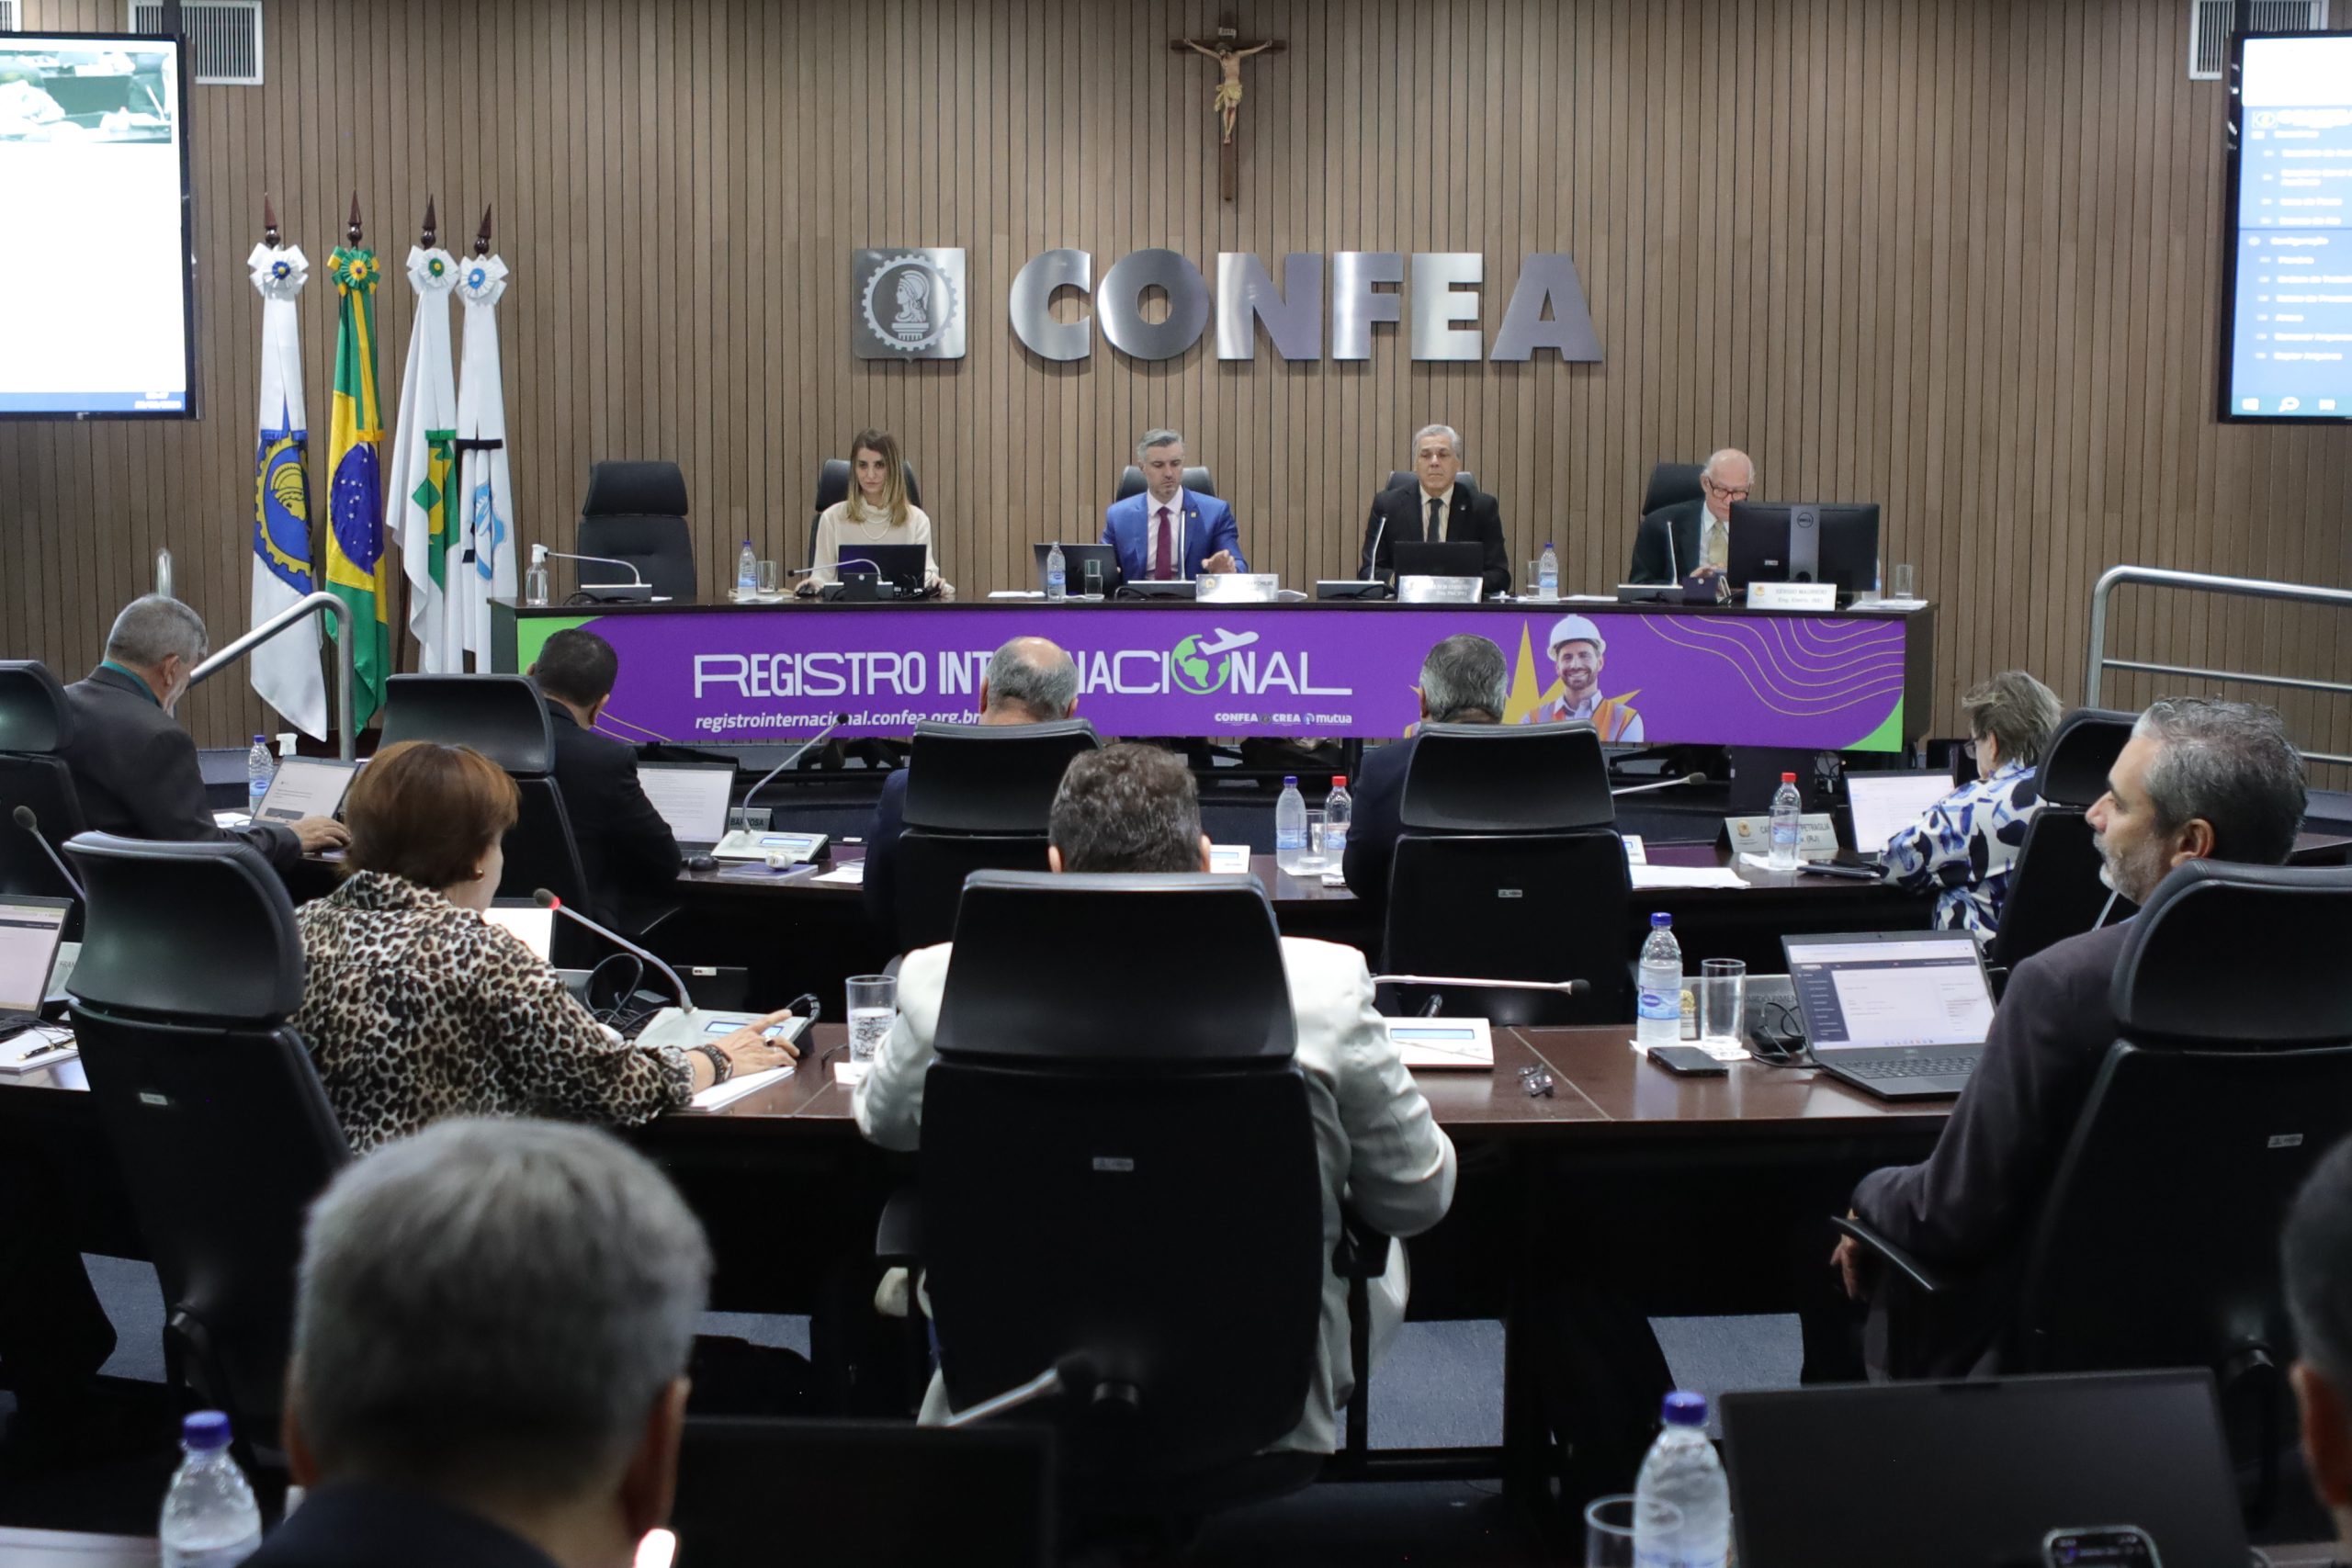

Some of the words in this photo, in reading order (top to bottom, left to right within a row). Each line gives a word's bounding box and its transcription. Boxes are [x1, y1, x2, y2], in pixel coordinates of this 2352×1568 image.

[1009, 247, 1603, 362] CONFEA
[694, 650, 927, 699] REGISTRO
[1215, 713, 1259, 722] CONFEA
[1272, 713, 1301, 722] CREA
[730, 818, 764, 826] BAOSA
